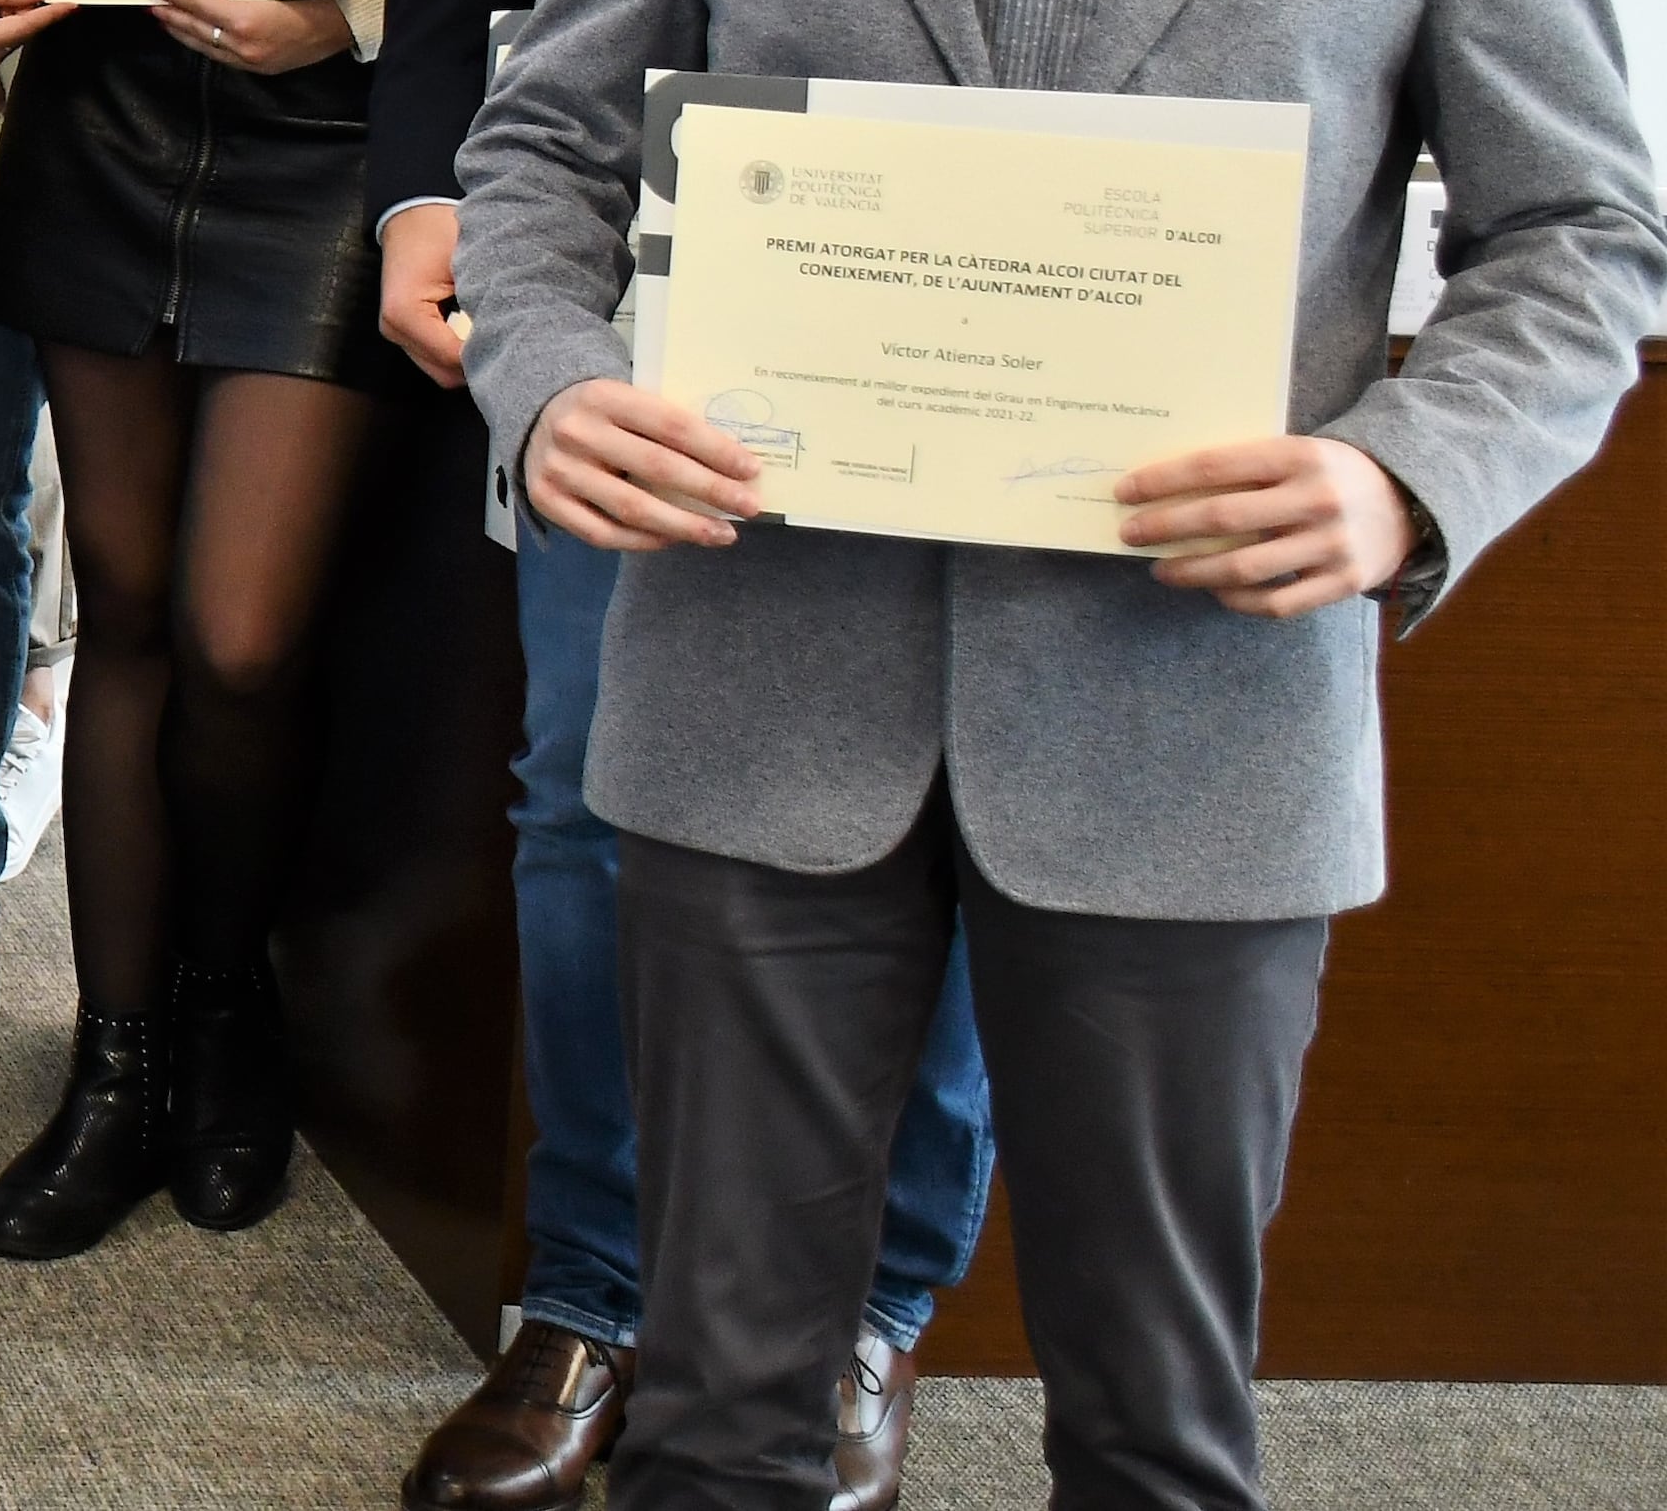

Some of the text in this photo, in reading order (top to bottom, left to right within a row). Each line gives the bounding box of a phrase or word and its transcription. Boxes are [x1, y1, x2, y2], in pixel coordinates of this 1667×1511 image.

[790, 166, 884, 185] UNIVERSITAT
[788, 192, 807, 206] DE
[1103, 186, 1162, 205] ESCOLA
[1083, 221, 1222, 246] SUPERIOR D'ALCOI
[764, 237, 1183, 288] PREMI ATORGAT PER LA CÀTEDRA ALCOI CIUTAT DEL
[798, 263, 1144, 306] CONEIXEMENT, DE L'AJUNTAMENT D'ALCOI
[933, 346, 997, 367] Atienza
[999, 352, 1043, 371] Soler
[753, 367, 768, 379] En
[769, 369, 858, 388] reconeixement
[861, 377, 871, 389] al
[874, 378, 908, 393] millor
[910, 382, 970, 401] expedient
[972, 388, 993, 401] del
[994, 390, 1025, 404] Grau
[1027, 393, 1042, 406] en
[1044, 395, 1110, 414] Enginyeria
[876, 395, 895, 409] del
[897, 397, 923, 412] curs
